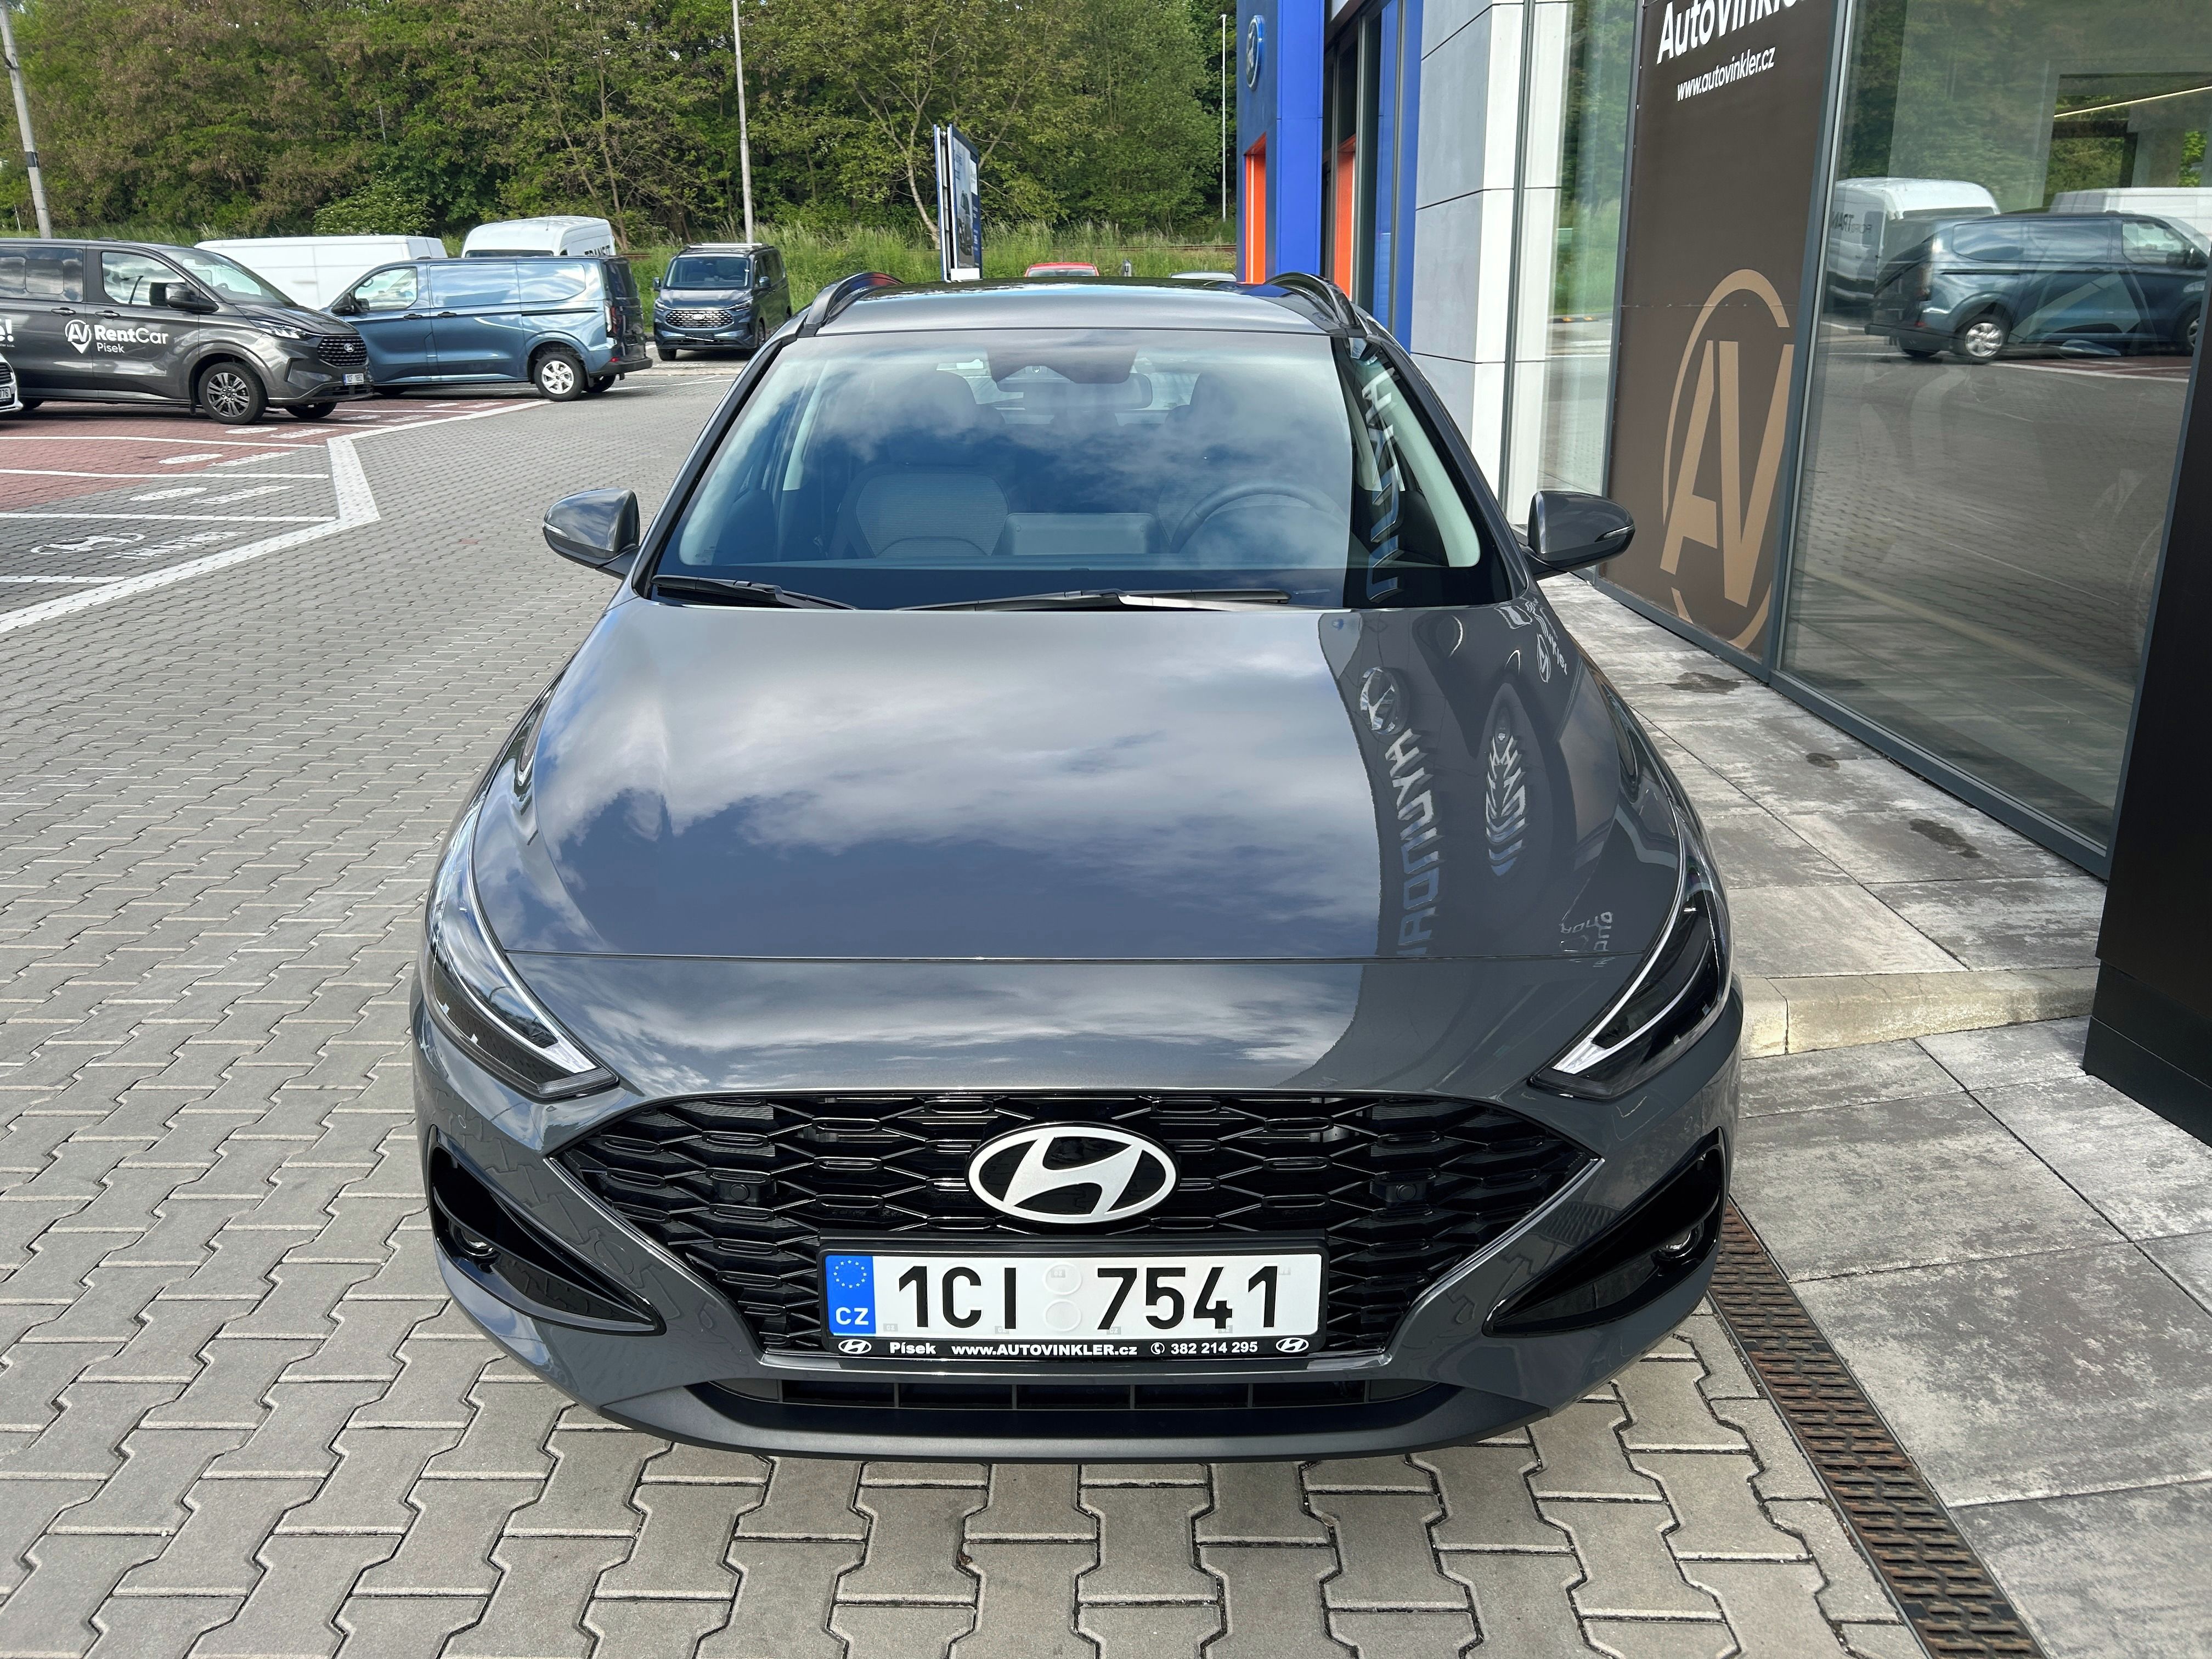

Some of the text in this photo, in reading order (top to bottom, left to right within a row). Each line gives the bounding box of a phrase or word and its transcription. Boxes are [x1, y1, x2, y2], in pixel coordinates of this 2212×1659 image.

[1677, 47, 1776, 102] www.autovinkler.cz
[94, 324, 168, 344] RentCar
[899, 1266, 1278, 1330] 1CI 7541
[836, 1306, 869, 1325] CZ
[889, 1341, 1258, 1356] Písek www.AUTOVINKLER.cz 382 214 295
